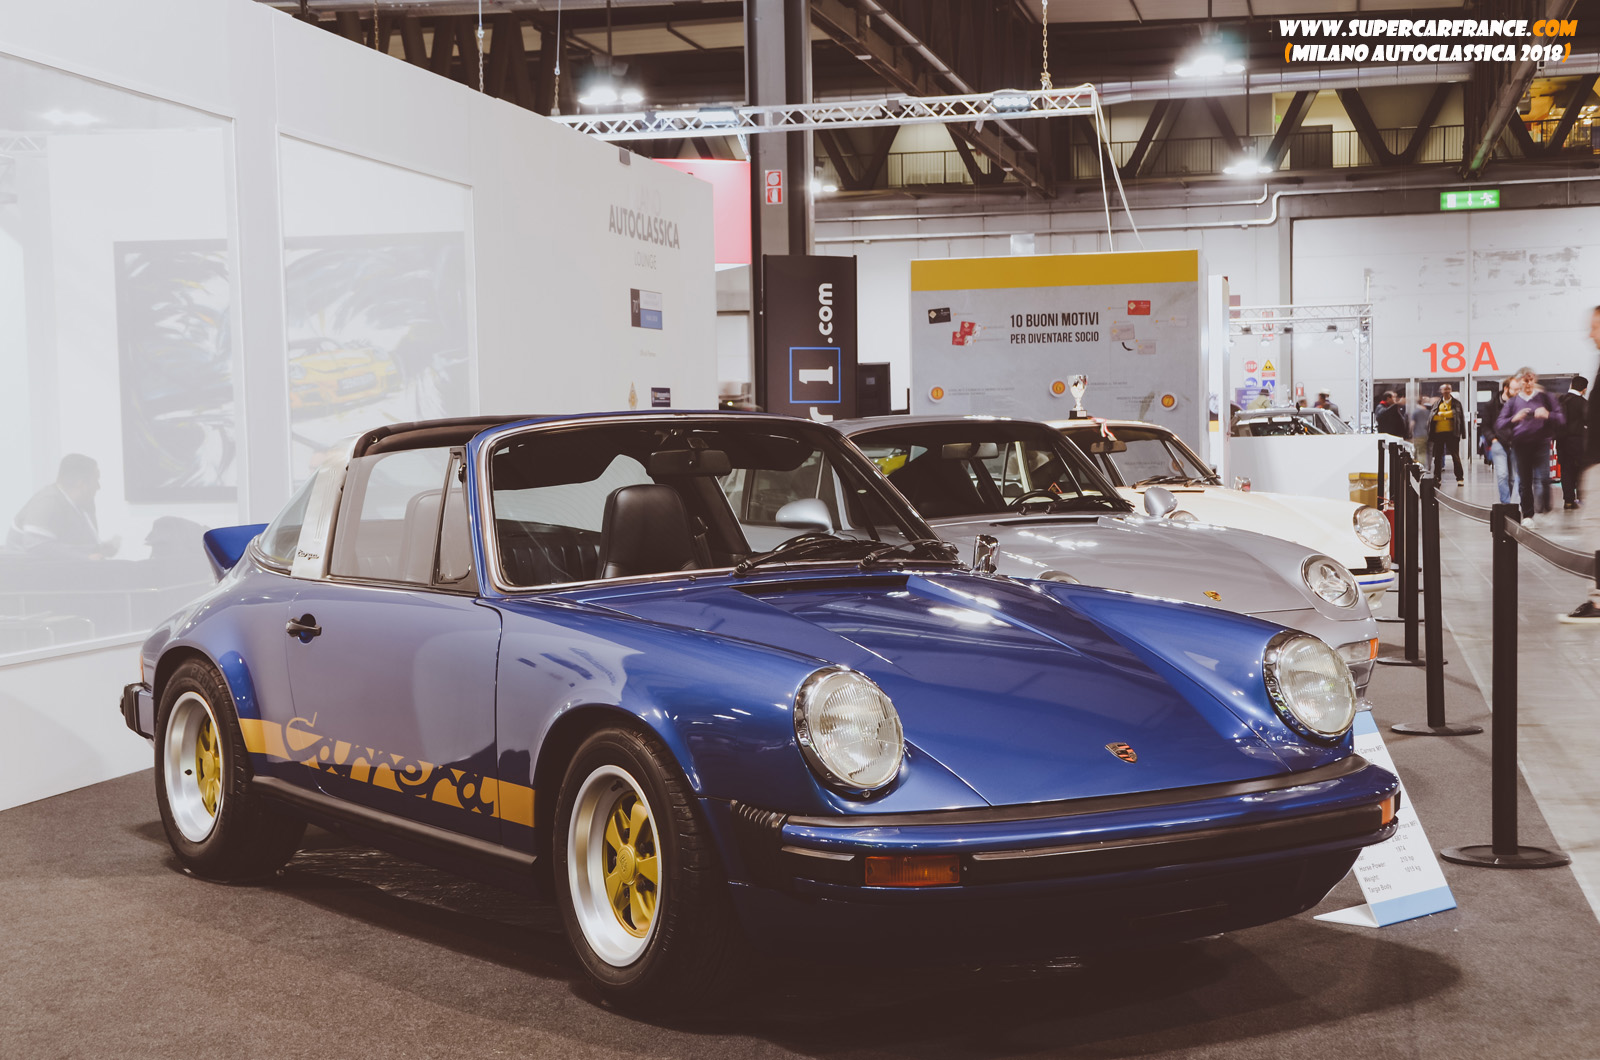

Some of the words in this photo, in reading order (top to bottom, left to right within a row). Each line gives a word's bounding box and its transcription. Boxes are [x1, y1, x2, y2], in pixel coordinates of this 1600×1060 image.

[608, 204, 680, 250] AUTOCLASSICA
[634, 252, 657, 270] LOUNGE
[1010, 314, 1023, 328] 10
[1026, 313, 1058, 327] BUONI
[1061, 312, 1099, 326] MOTIVI
[1010, 333, 1026, 344] PER
[1028, 332, 1073, 343] DIVENTARE
[1075, 331, 1099, 342] SOCIO
[1422, 342, 1467, 373] 18
[1471, 341, 1500, 372] A
[281, 711, 494, 816] Carrera
